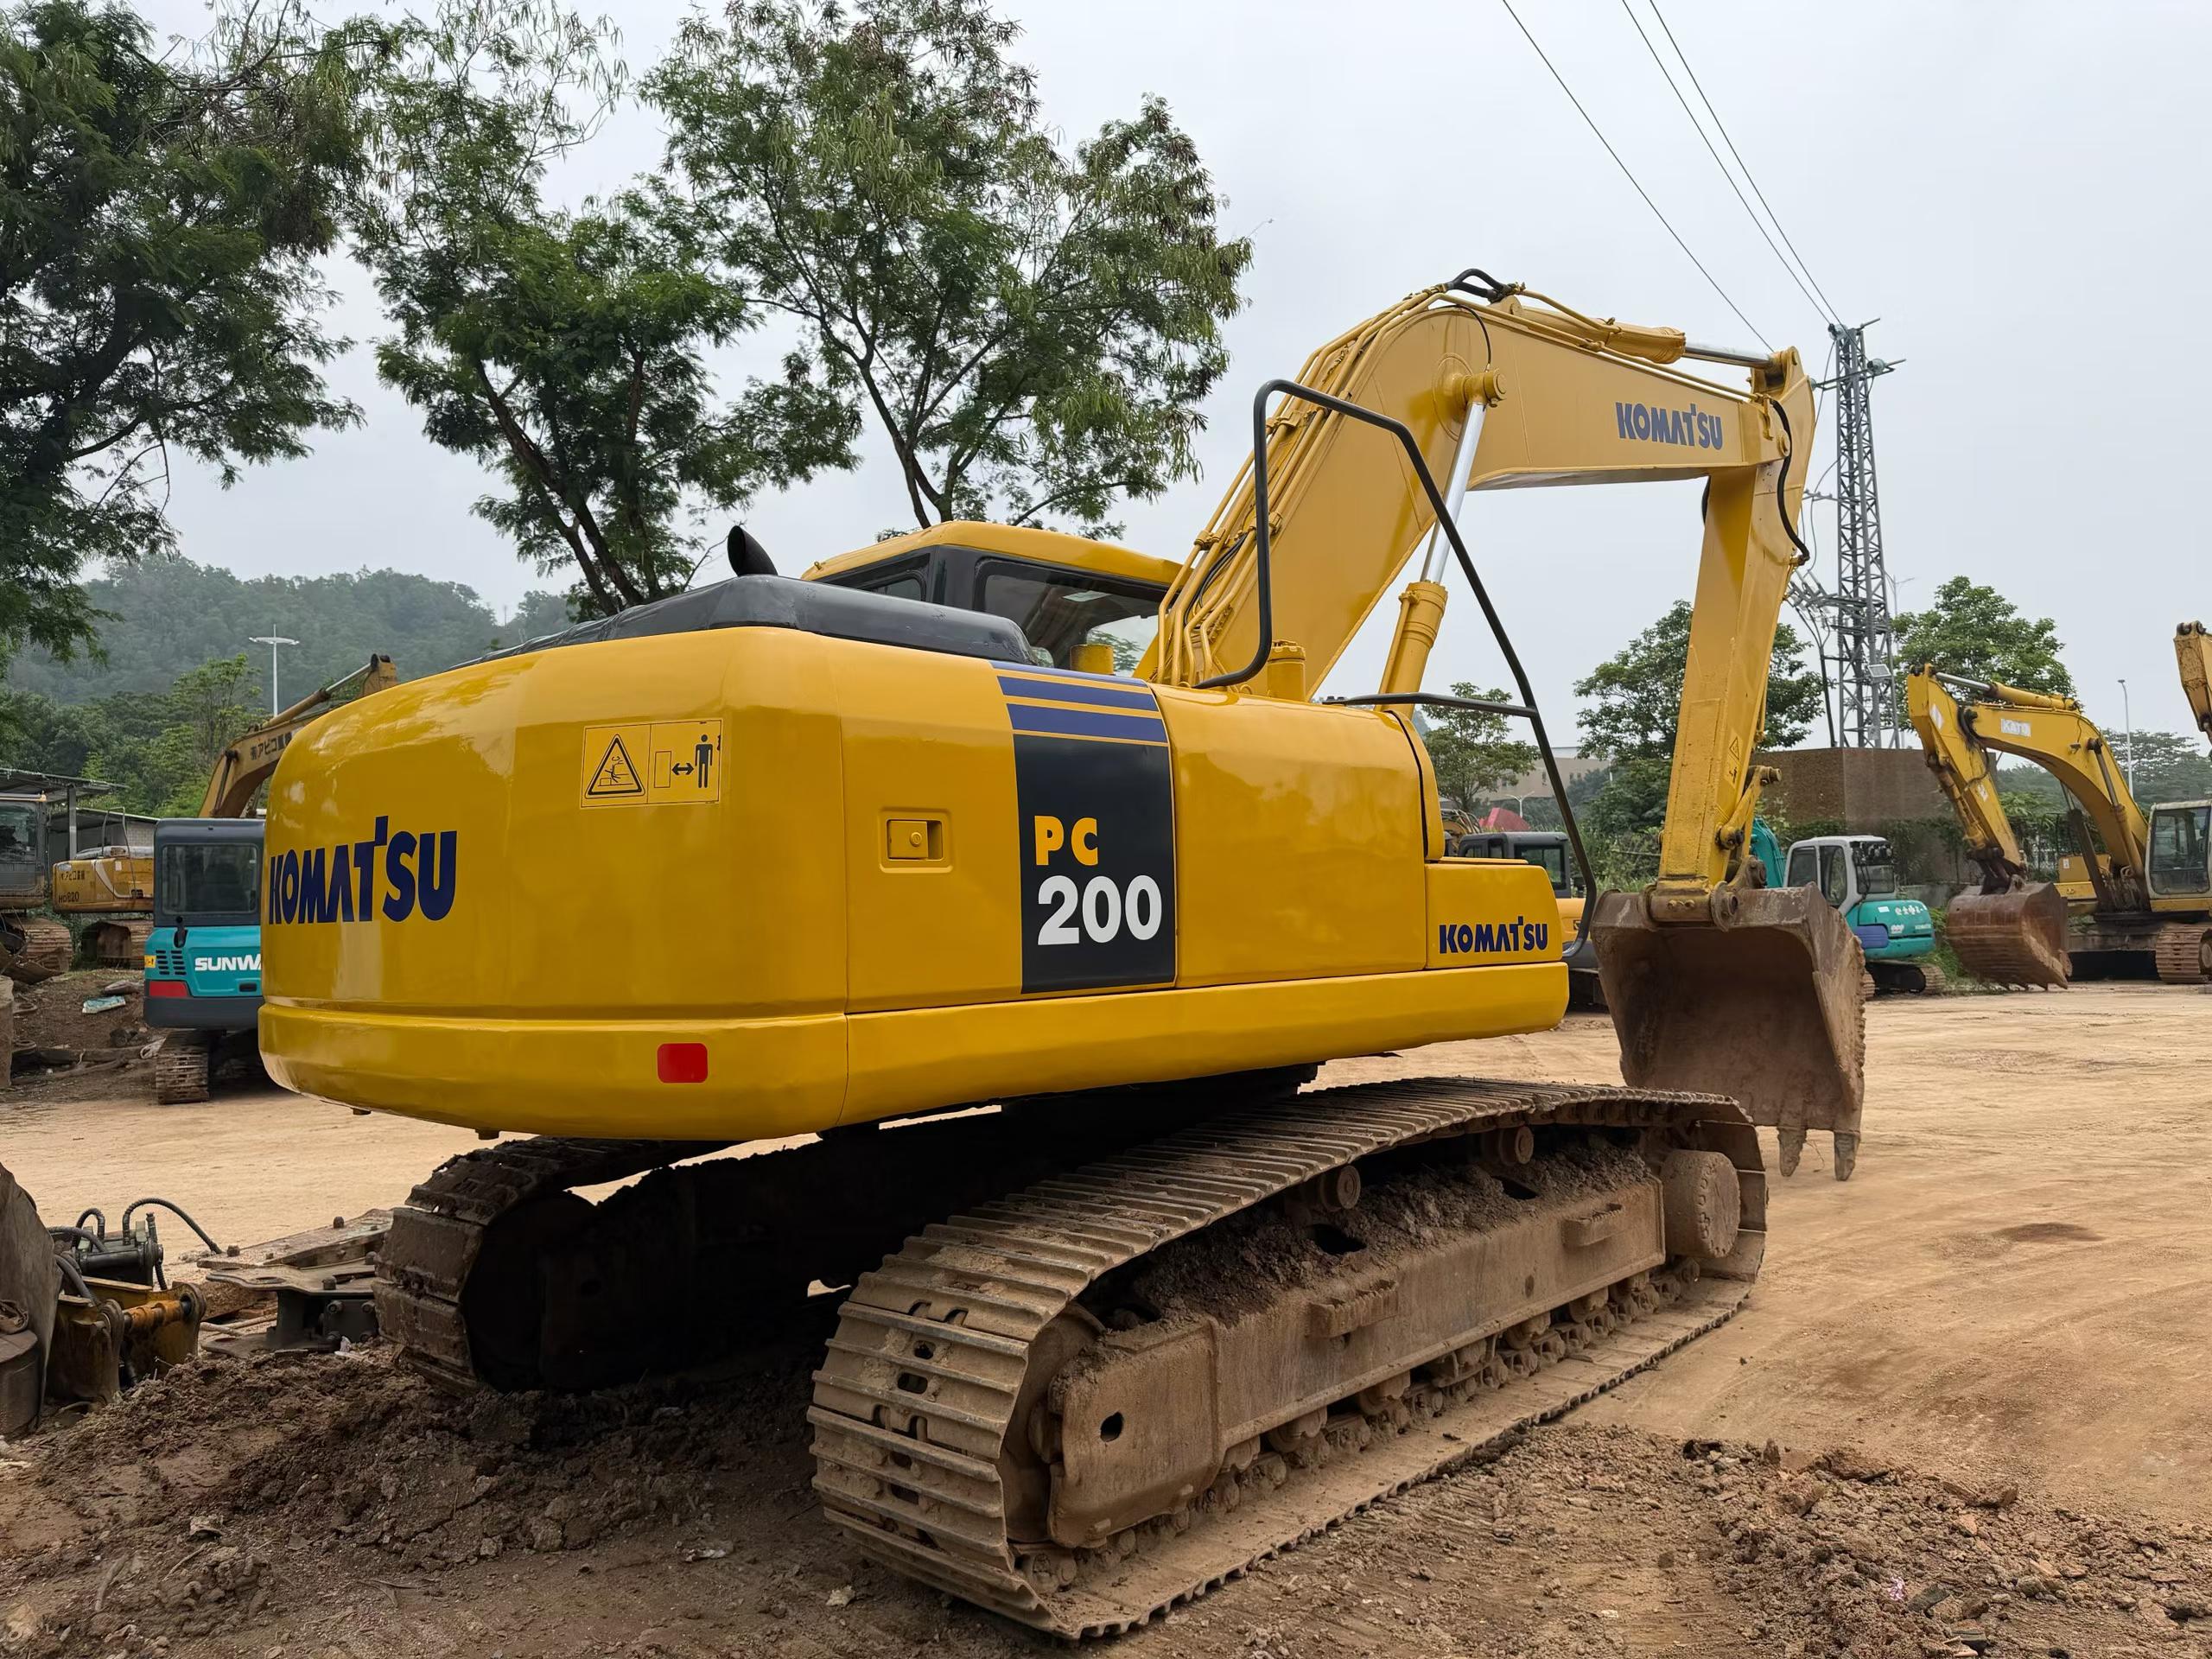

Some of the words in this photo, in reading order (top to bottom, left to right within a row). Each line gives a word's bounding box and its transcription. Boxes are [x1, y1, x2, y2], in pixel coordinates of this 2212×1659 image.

[1616, 402, 1723, 450] KOMATSU
[1034, 815, 1098, 866] PC
[269, 815, 457, 925] KOMATSU
[1038, 874, 1162, 945] 200
[1439, 916, 1548, 954] KOMATSU
